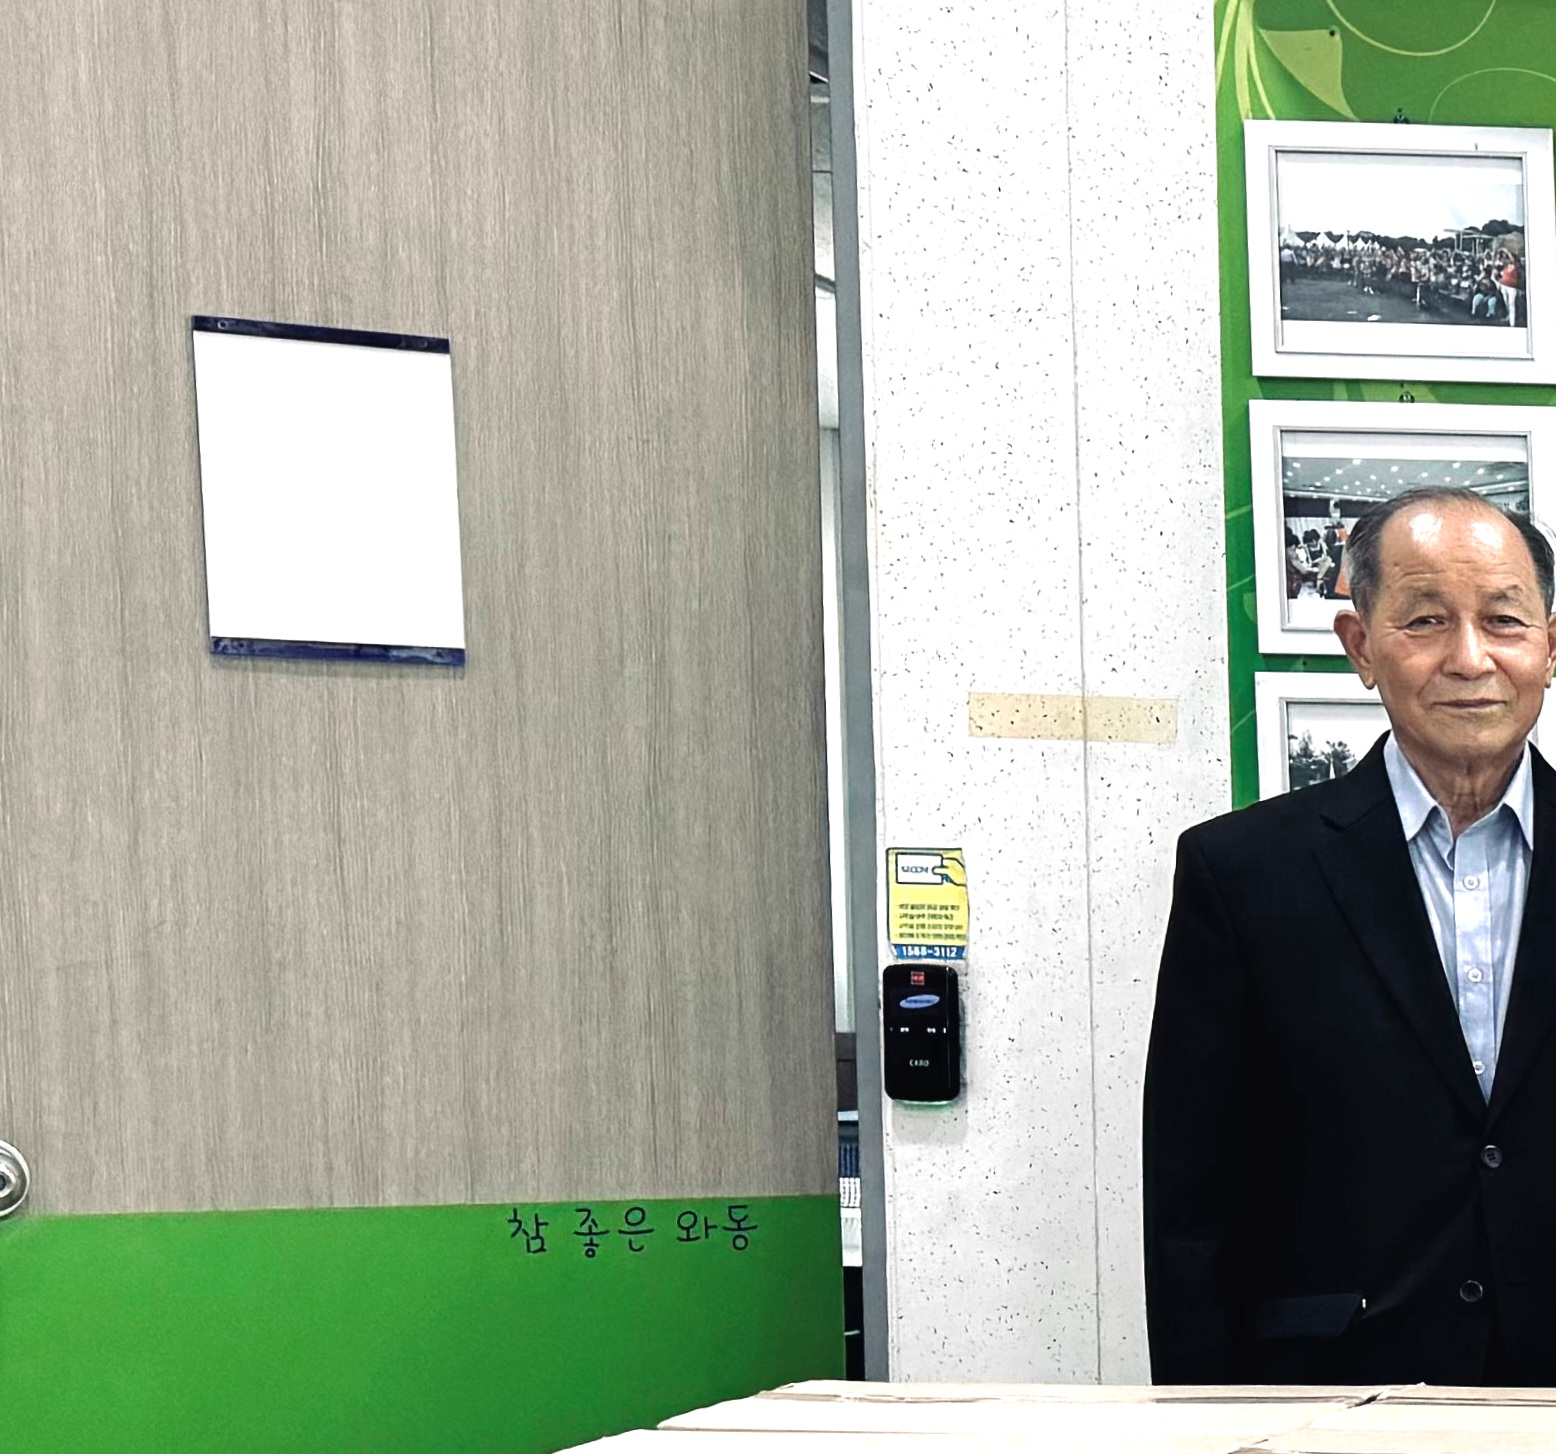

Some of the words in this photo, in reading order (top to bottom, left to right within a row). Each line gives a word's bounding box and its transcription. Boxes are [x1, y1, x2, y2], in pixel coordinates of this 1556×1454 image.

[508, 1208, 549, 1253] 참
[573, 1207, 654, 1258] 좋은
[677, 1205, 758, 1251] 와동
